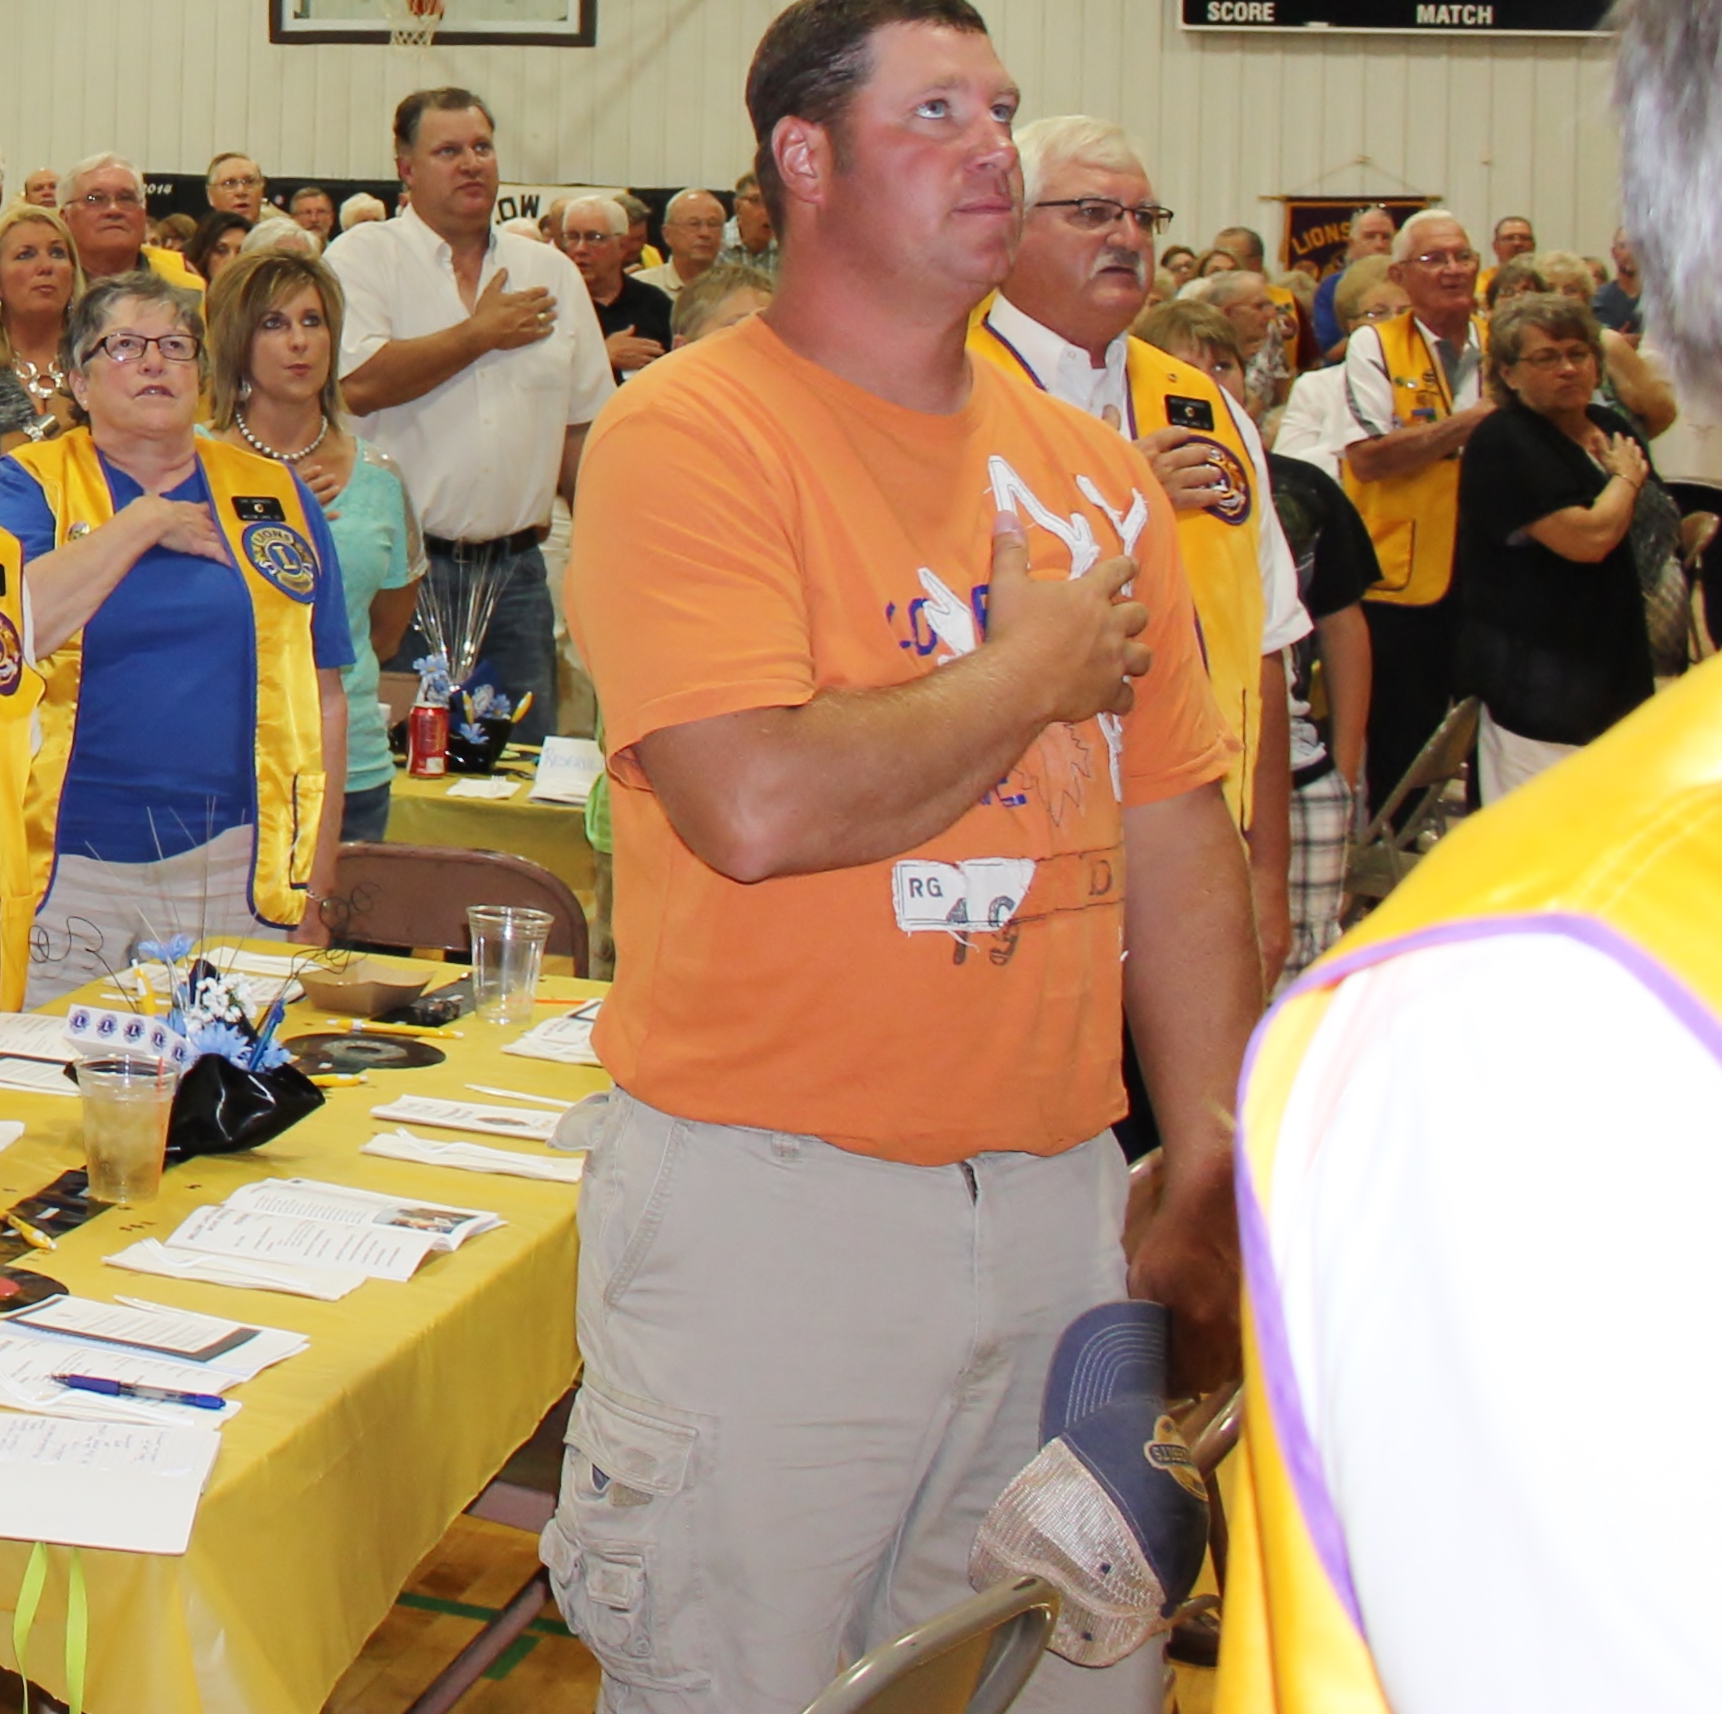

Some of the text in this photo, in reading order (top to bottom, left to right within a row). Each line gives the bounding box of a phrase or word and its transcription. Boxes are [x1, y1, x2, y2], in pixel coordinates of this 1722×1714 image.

[1207, 2, 1493, 25] SCORE MATCH
[142, 183, 173, 194] 014
[908, 877, 943, 898] RG
